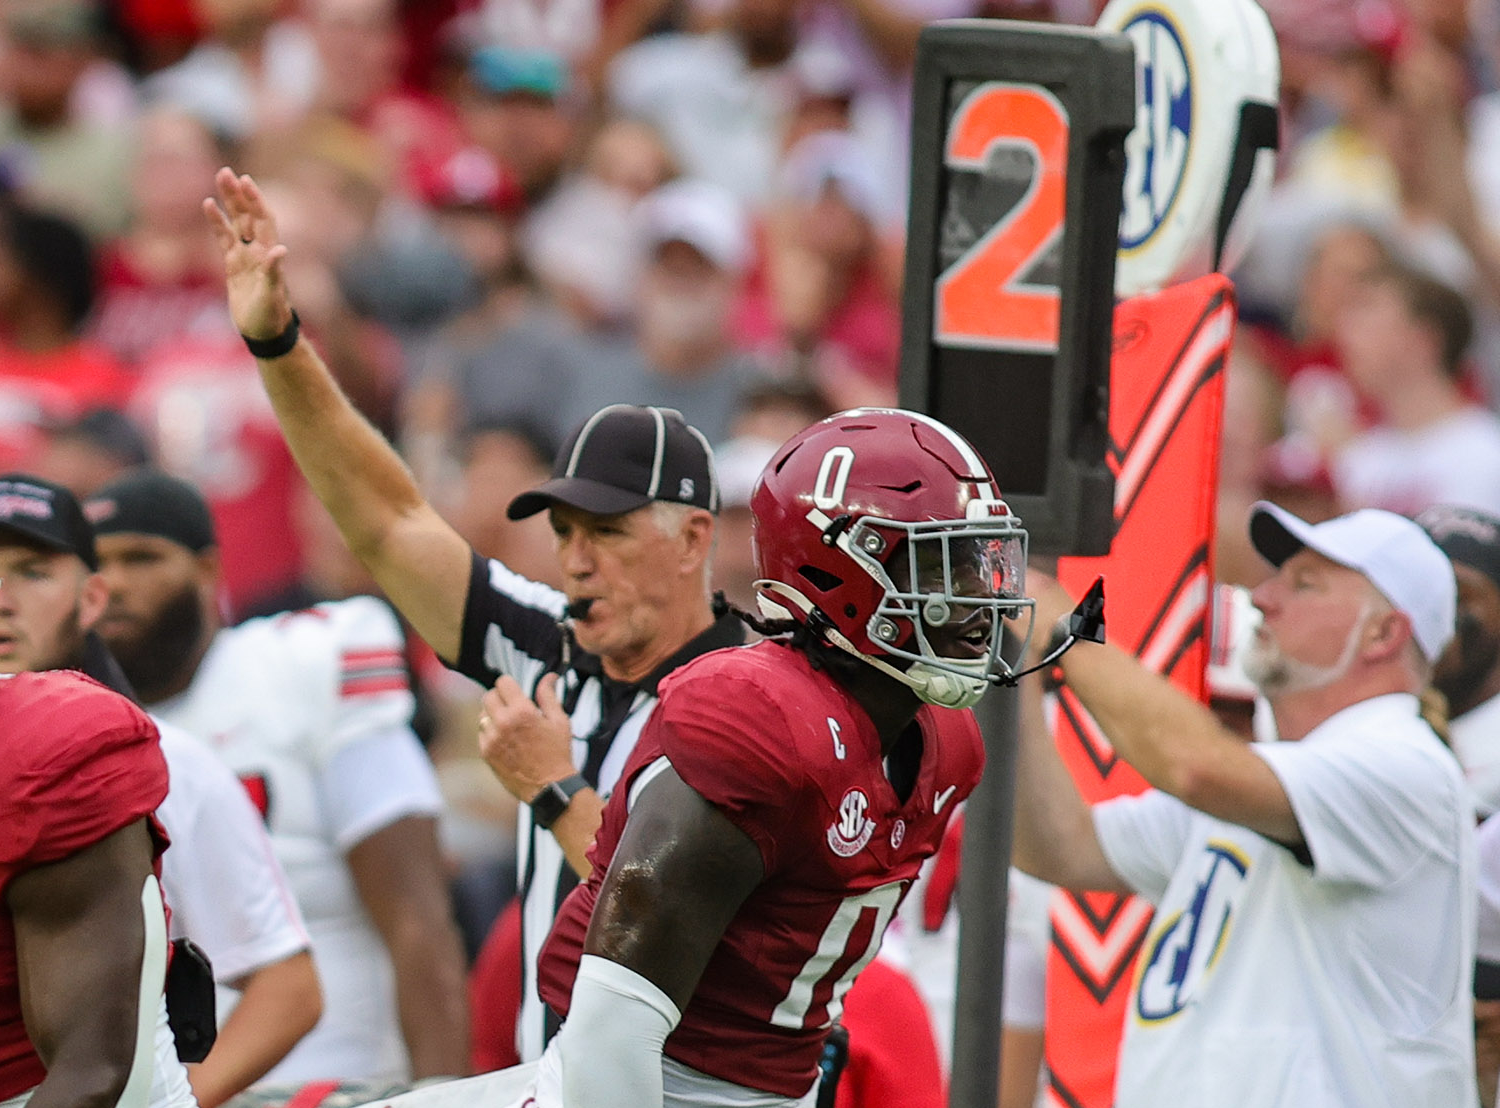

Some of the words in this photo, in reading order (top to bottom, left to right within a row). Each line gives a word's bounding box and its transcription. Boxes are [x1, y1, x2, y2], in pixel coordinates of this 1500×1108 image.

[933, 80, 1070, 355] 2
[813, 446, 856, 510] 0
[837, 789, 869, 840] SEC
